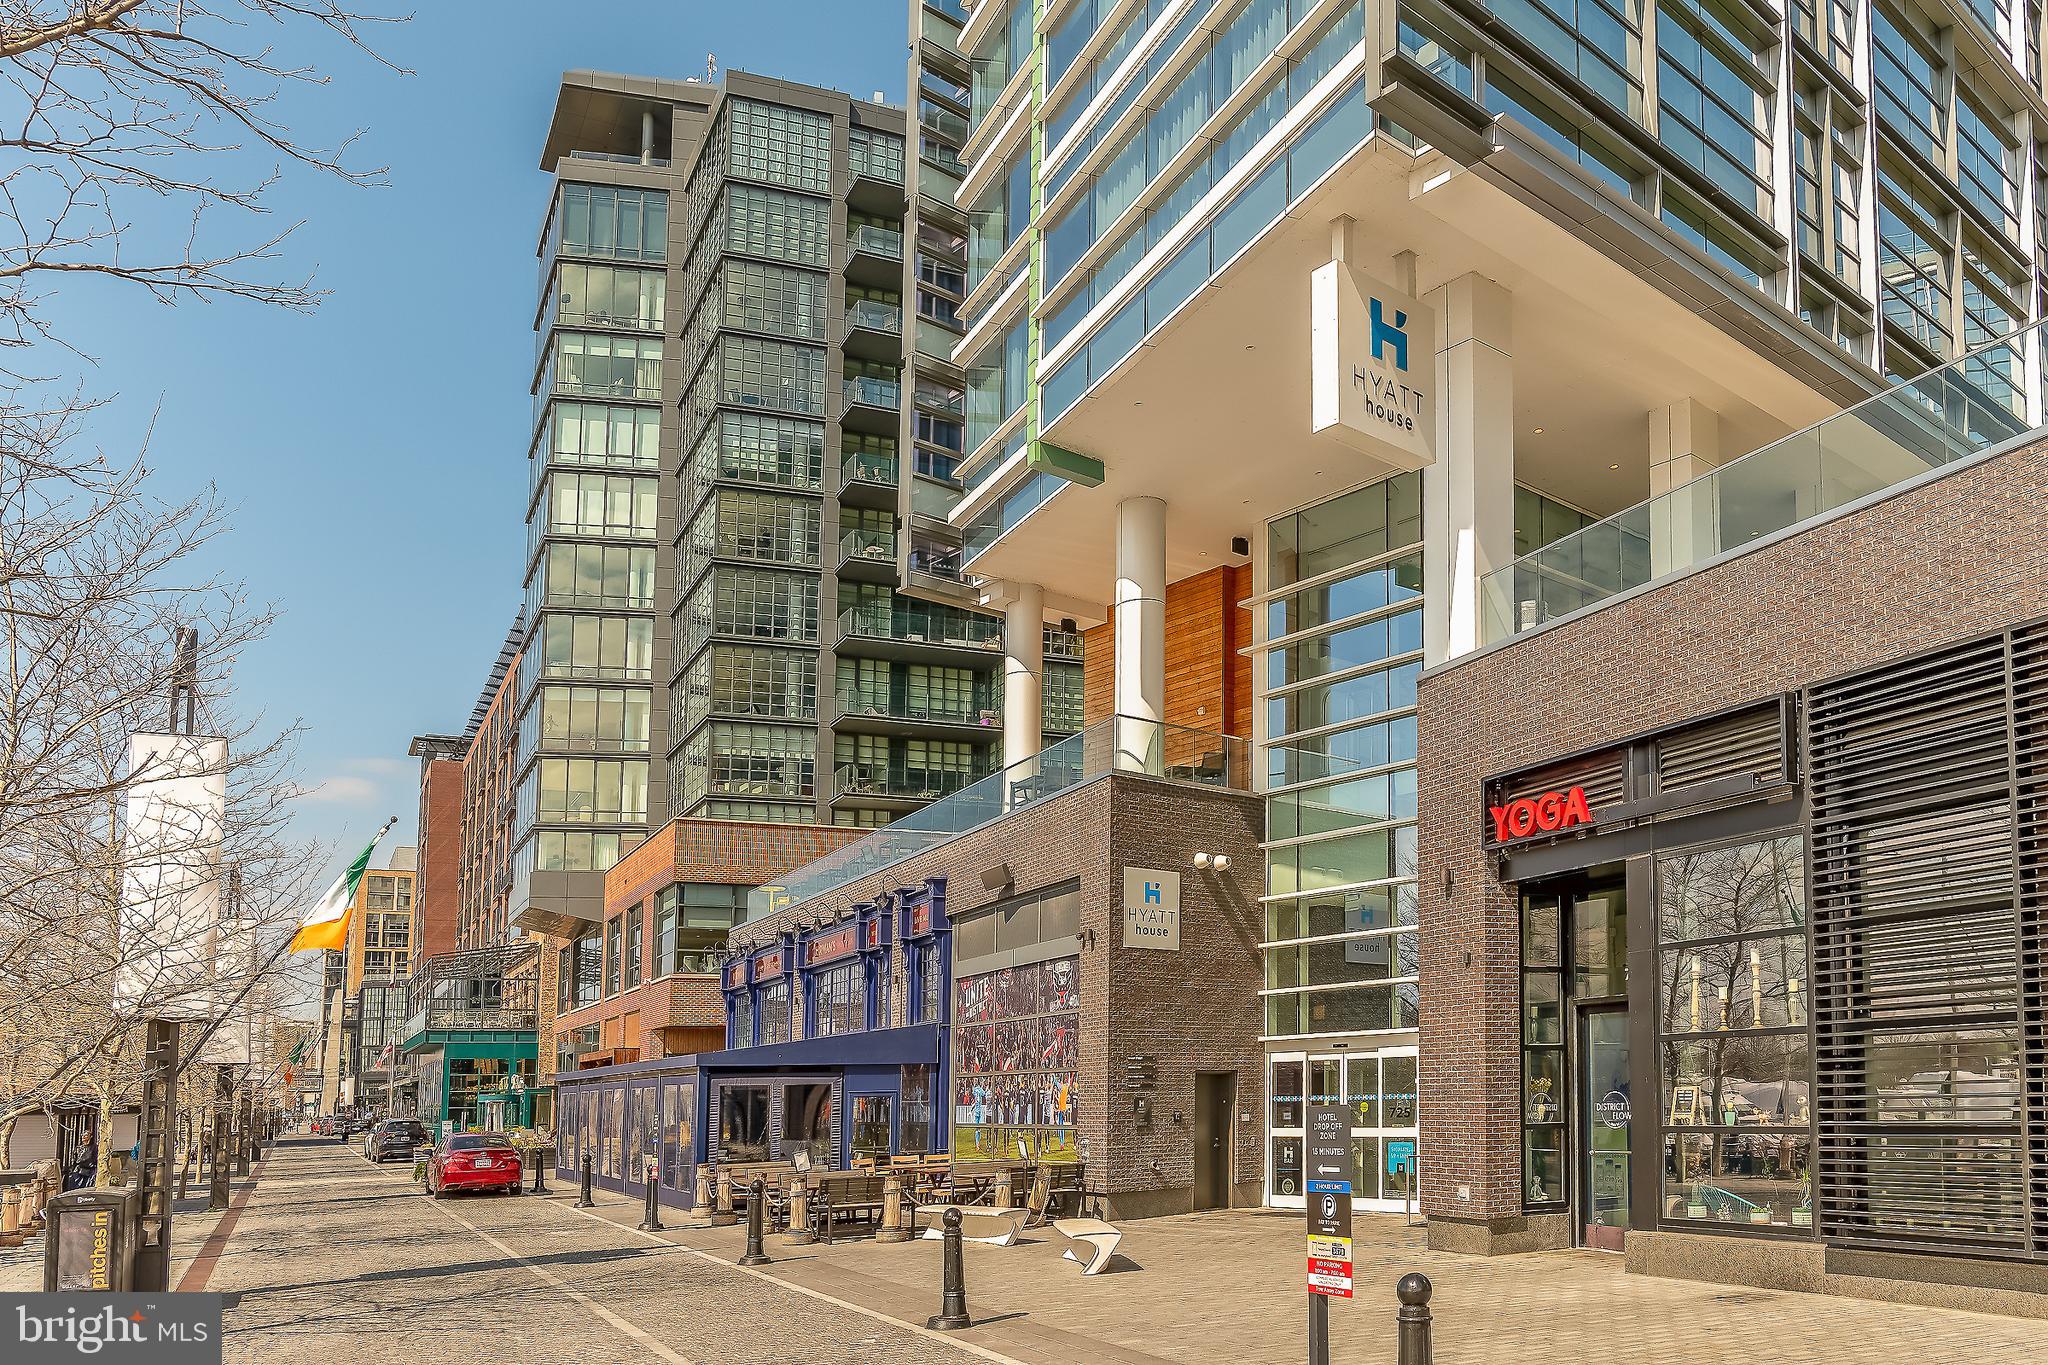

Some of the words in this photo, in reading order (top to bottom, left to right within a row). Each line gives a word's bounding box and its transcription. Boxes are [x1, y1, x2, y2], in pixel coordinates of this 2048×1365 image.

[1353, 364, 1424, 415] HYATT
[1366, 394, 1413, 431] house
[1489, 785, 1593, 842] YOGA
[1128, 907, 1176, 925] HYATT
[1135, 924, 1169, 937] house
[1390, 1108, 1411, 1118] 725
[1596, 1102, 1625, 1111] DISTRICT
[1318, 1113, 1338, 1121] HOTEL
[1313, 1122, 1330, 1130] DROP
[1330, 1122, 1343, 1130] OFF
[1319, 1131, 1336, 1140] ZONE
[1312, 1147, 1319, 1156] 15
[1319, 1147, 1345, 1156] MINUTES
[1325, 1199, 1333, 1214] P
[91, 1211, 108, 1227] in
[89, 1228, 110, 1289] pitches
